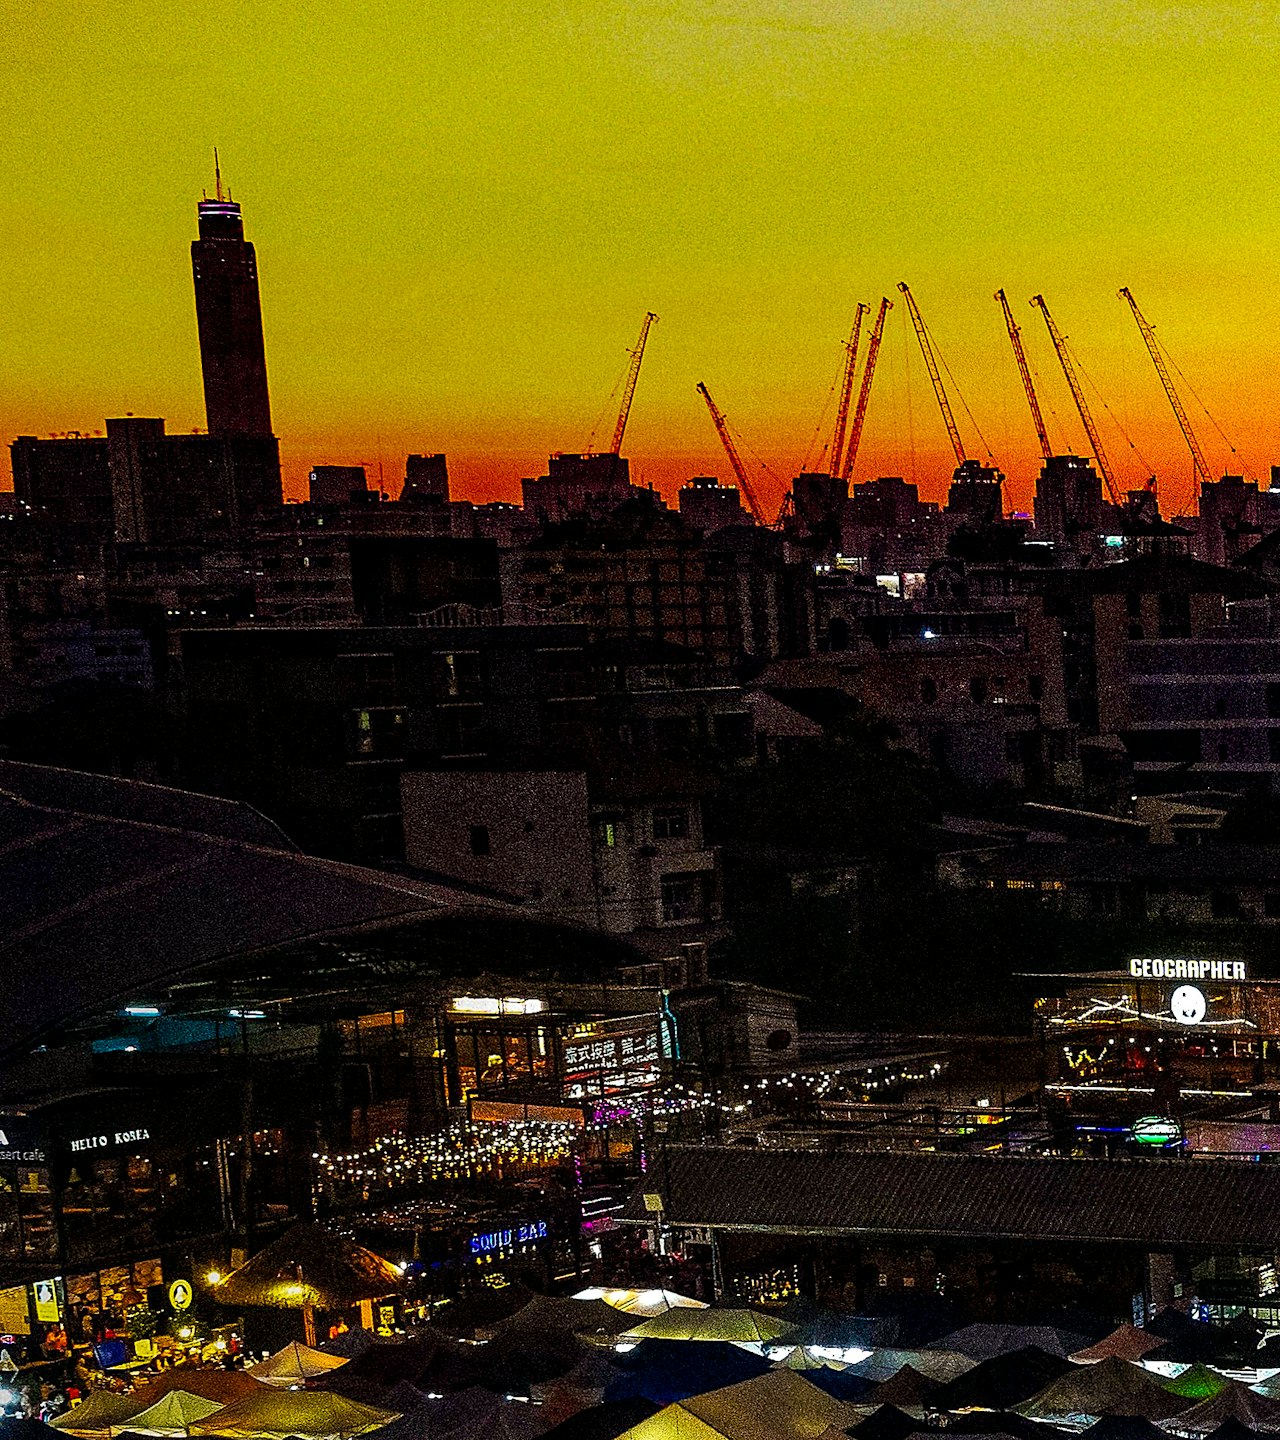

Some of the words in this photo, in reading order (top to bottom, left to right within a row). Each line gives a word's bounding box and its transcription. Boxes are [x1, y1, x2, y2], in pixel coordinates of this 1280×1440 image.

[1130, 958, 1246, 980] GEOGRAPHER
[71, 1135, 108, 1152] HELLO
[114, 1128, 150, 1145] KOREA
[471, 1229, 513, 1253] SQUID
[519, 1220, 548, 1243] BAR
